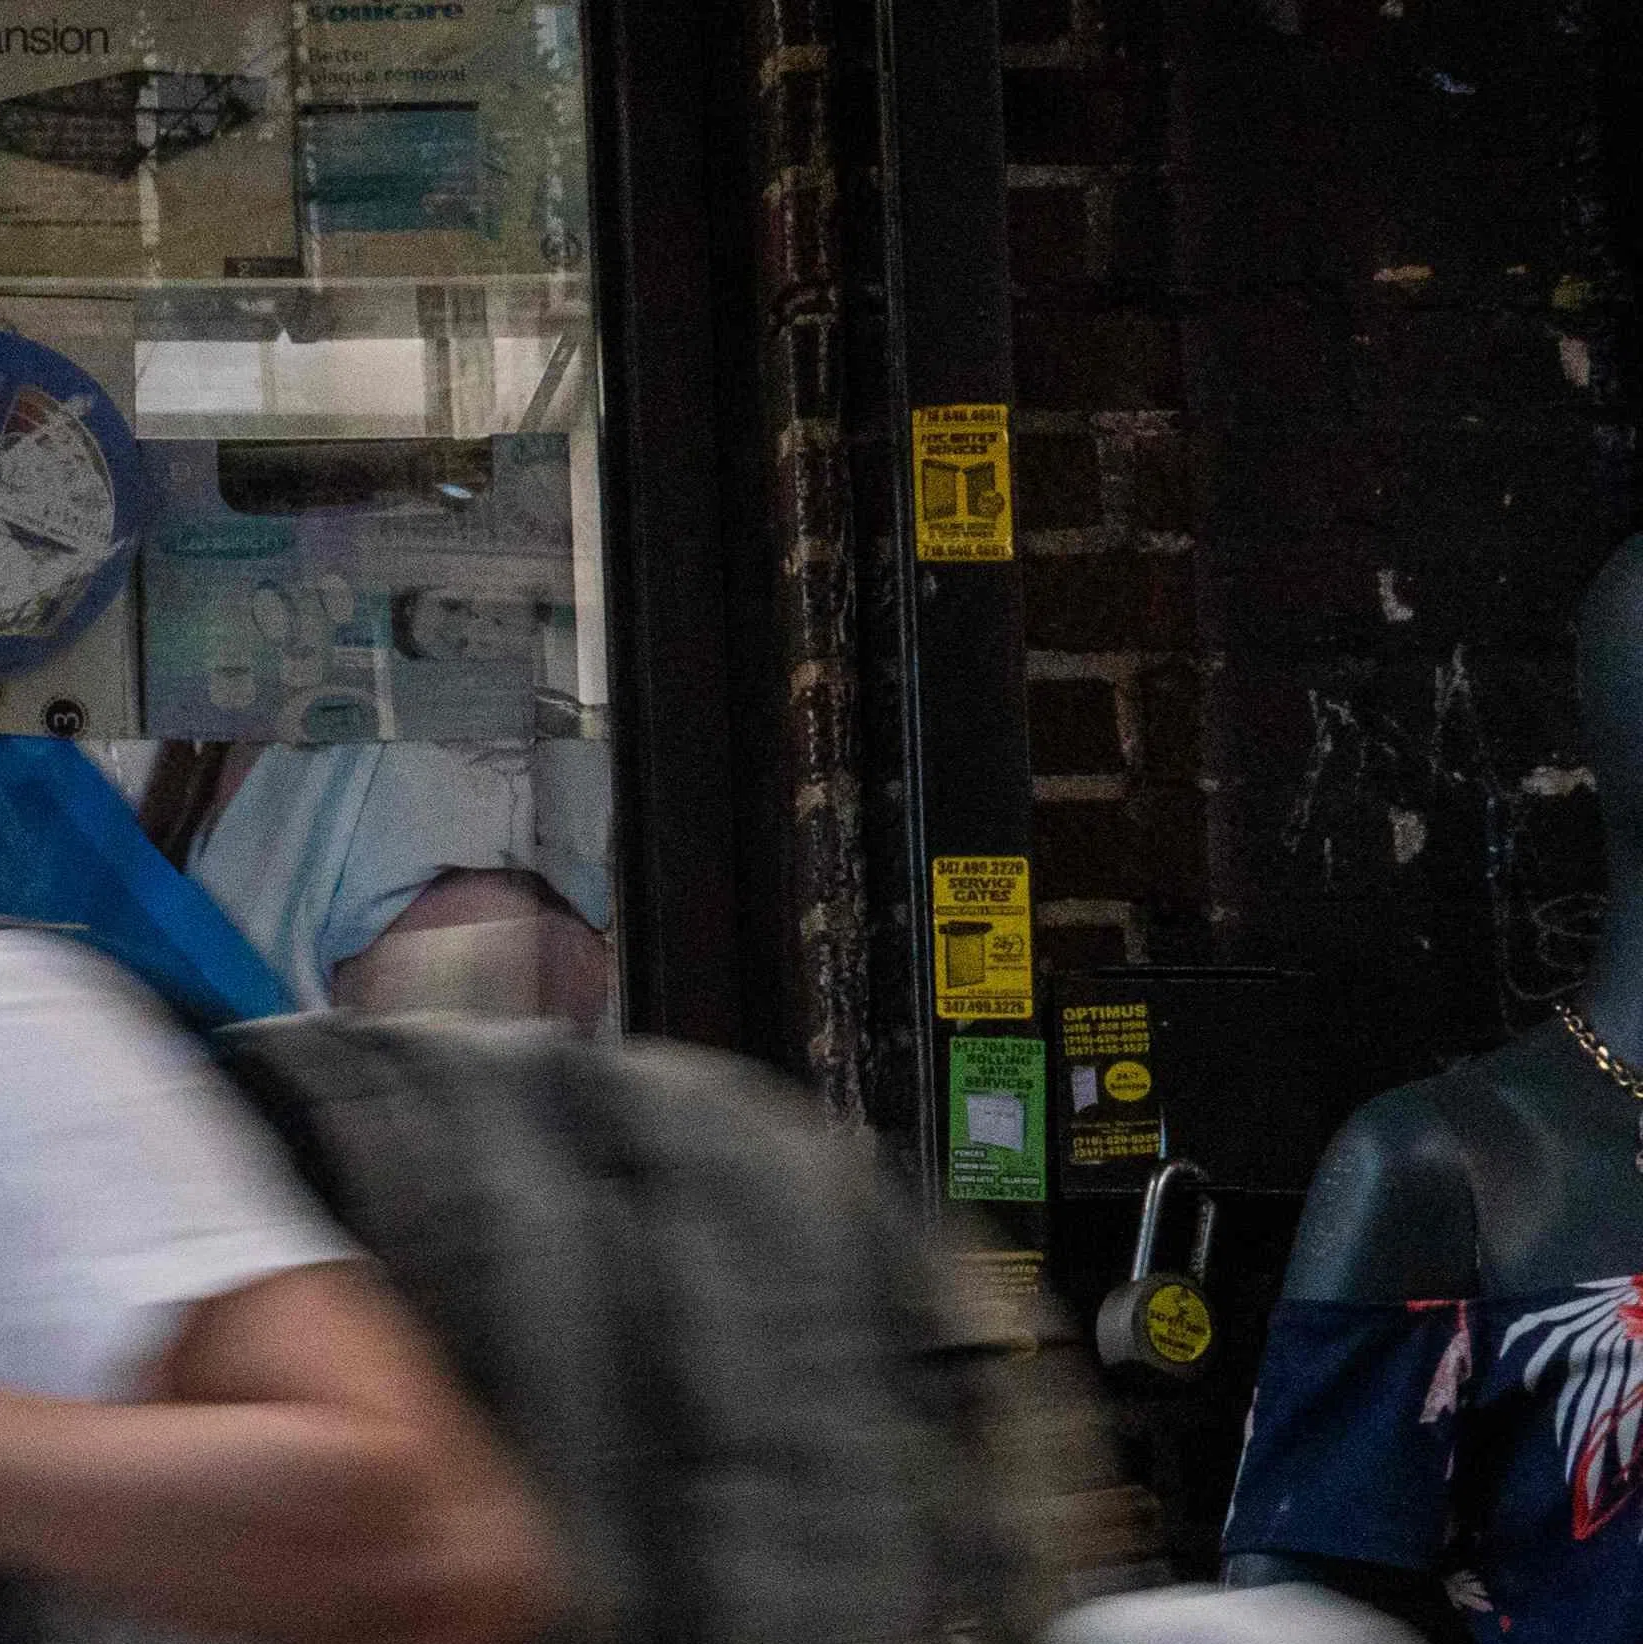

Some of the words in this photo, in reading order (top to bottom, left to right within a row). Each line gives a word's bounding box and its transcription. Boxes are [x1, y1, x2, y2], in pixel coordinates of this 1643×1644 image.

[949, 878, 1015, 889] SERVICE
[954, 890, 1010, 901] GATES
[1062, 1005, 1147, 1020] OPTIMUS
[966, 1055, 1031, 1065] ROLLING
[966, 1077, 1033, 1089] SERVICES
